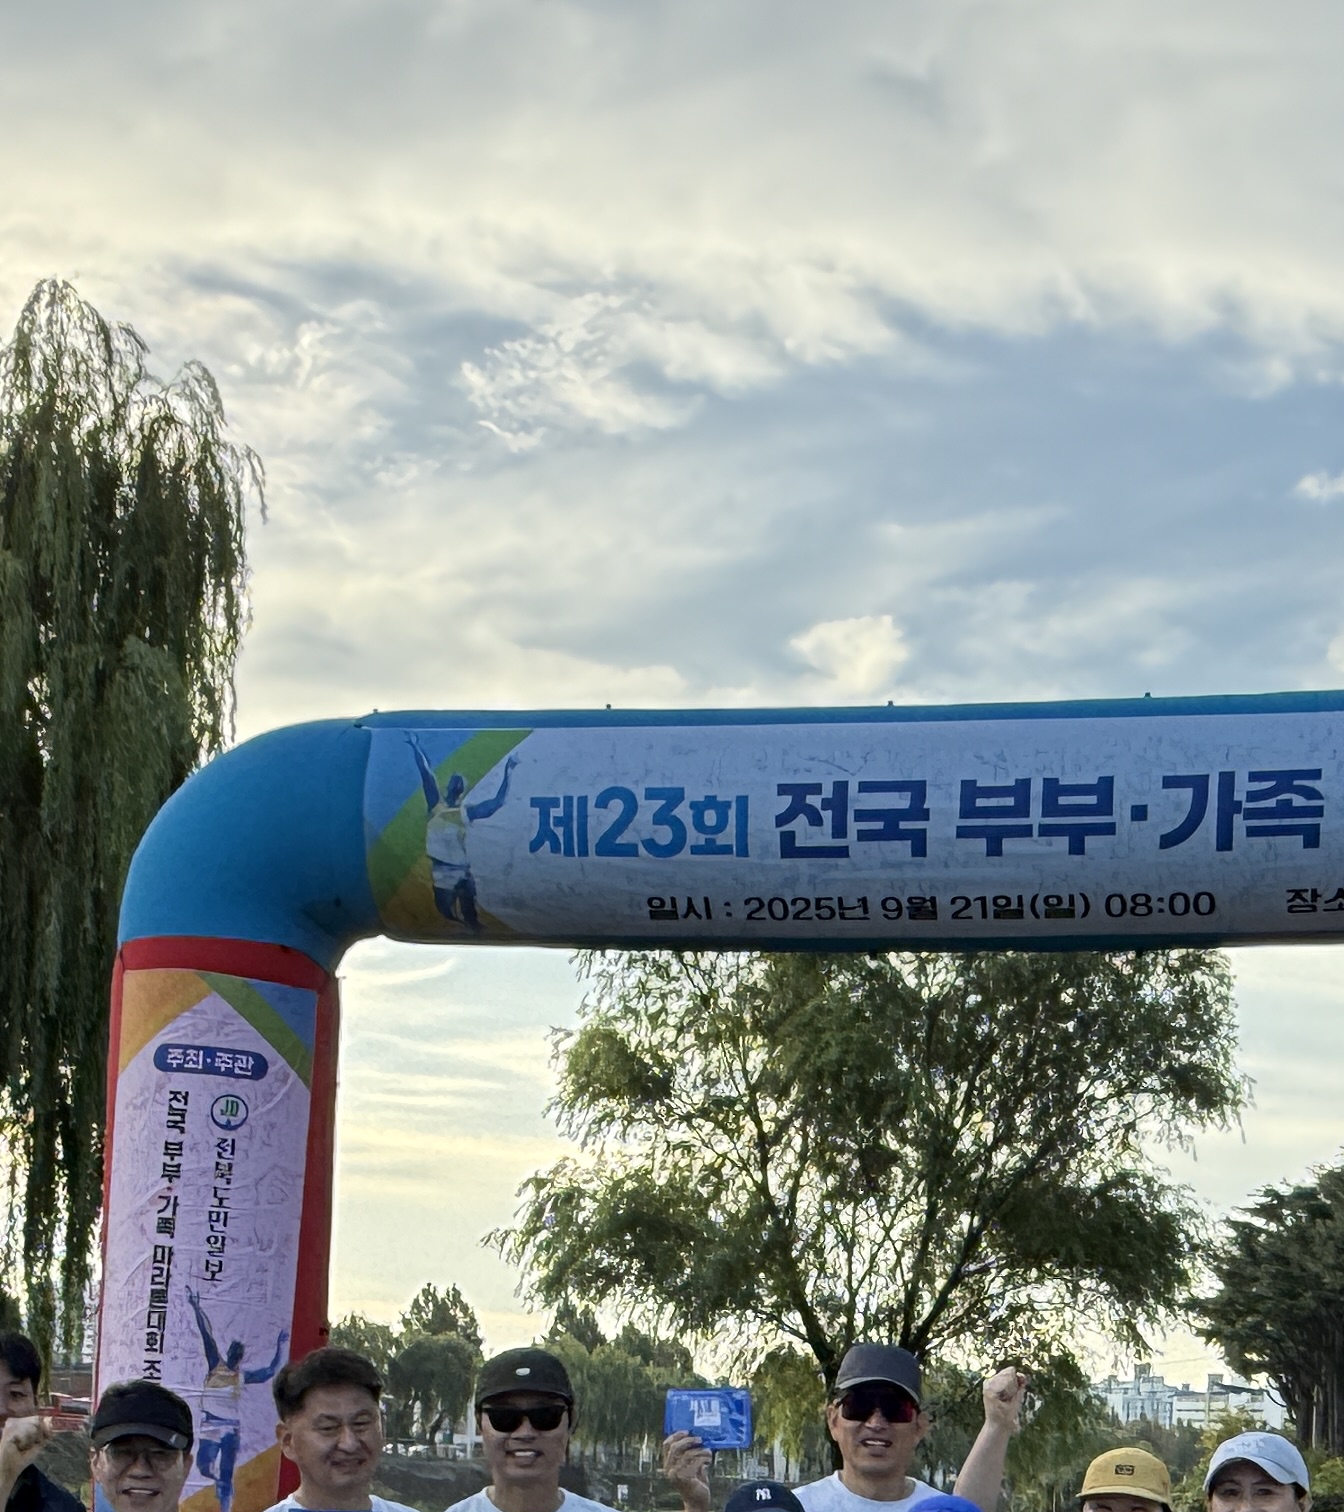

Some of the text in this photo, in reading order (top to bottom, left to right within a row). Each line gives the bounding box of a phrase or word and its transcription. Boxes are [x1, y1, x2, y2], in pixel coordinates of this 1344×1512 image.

[528, 786, 750, 858] 제23회
[774, 780, 931, 859] 전국
[956, 768, 1325, 857] 부부·가족
[646, 896, 713, 921] 일시
[744, 895, 870, 921] 2025년
[881, 894, 938, 920] 9월
[950, 892, 1090, 920] 21일(일)
[1105, 891, 1217, 918] 08:00
[205, 1137, 236, 1282] 전북도민일보
